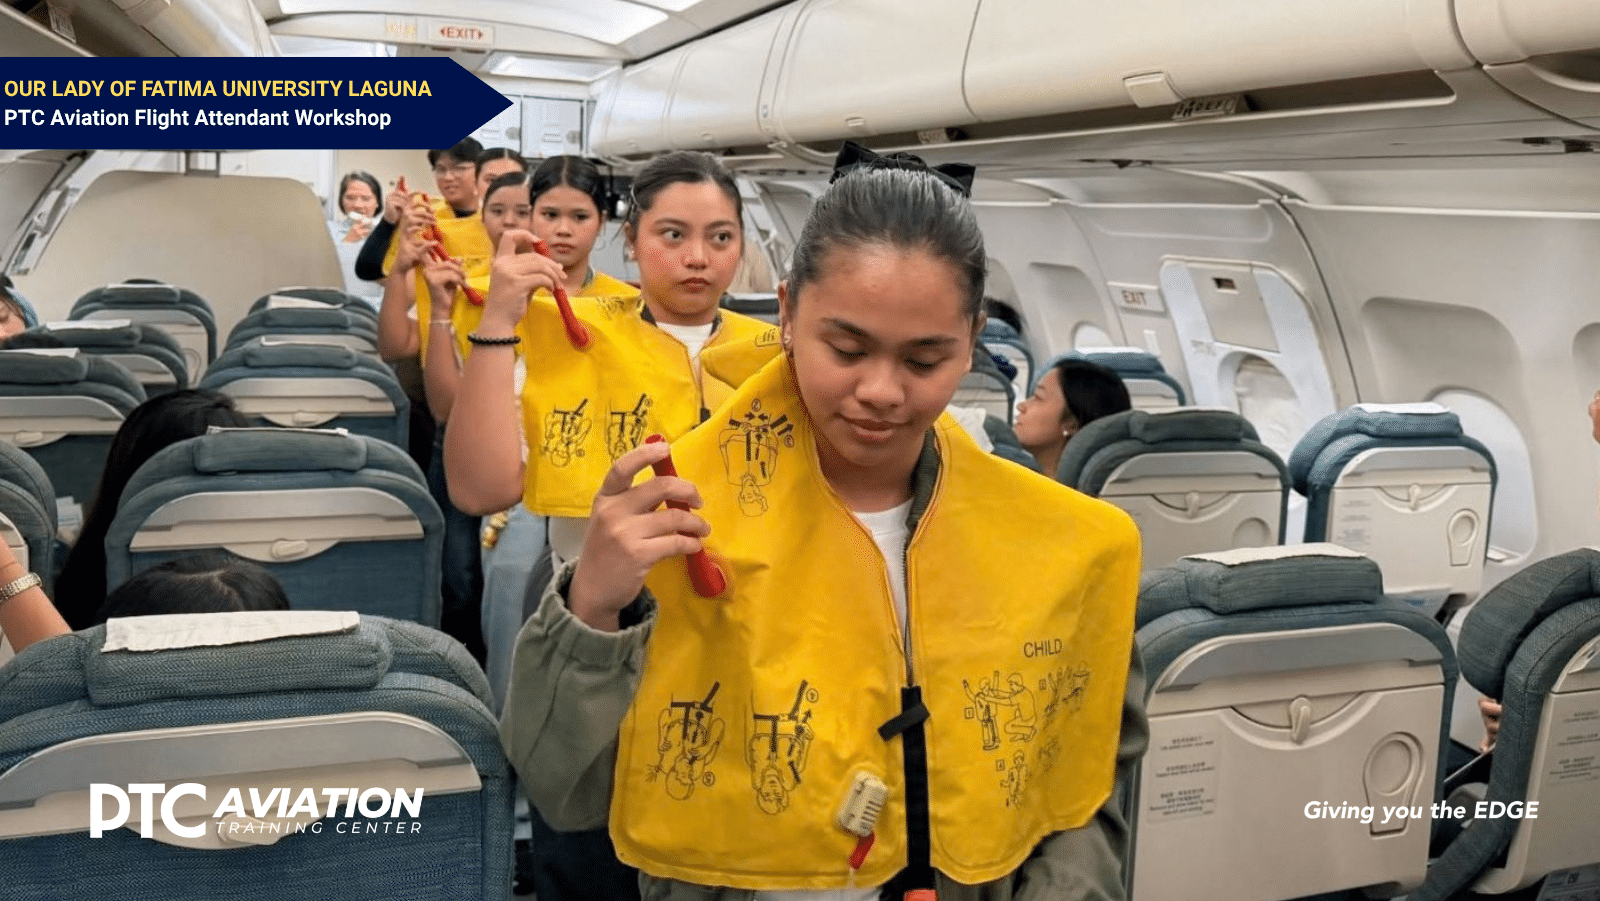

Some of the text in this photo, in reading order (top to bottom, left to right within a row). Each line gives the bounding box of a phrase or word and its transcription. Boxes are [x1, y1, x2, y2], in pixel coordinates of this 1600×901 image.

[446, 27, 475, 38] EXIT
[1121, 289, 1146, 305] EXIT
[1023, 639, 1063, 659] CHILD
